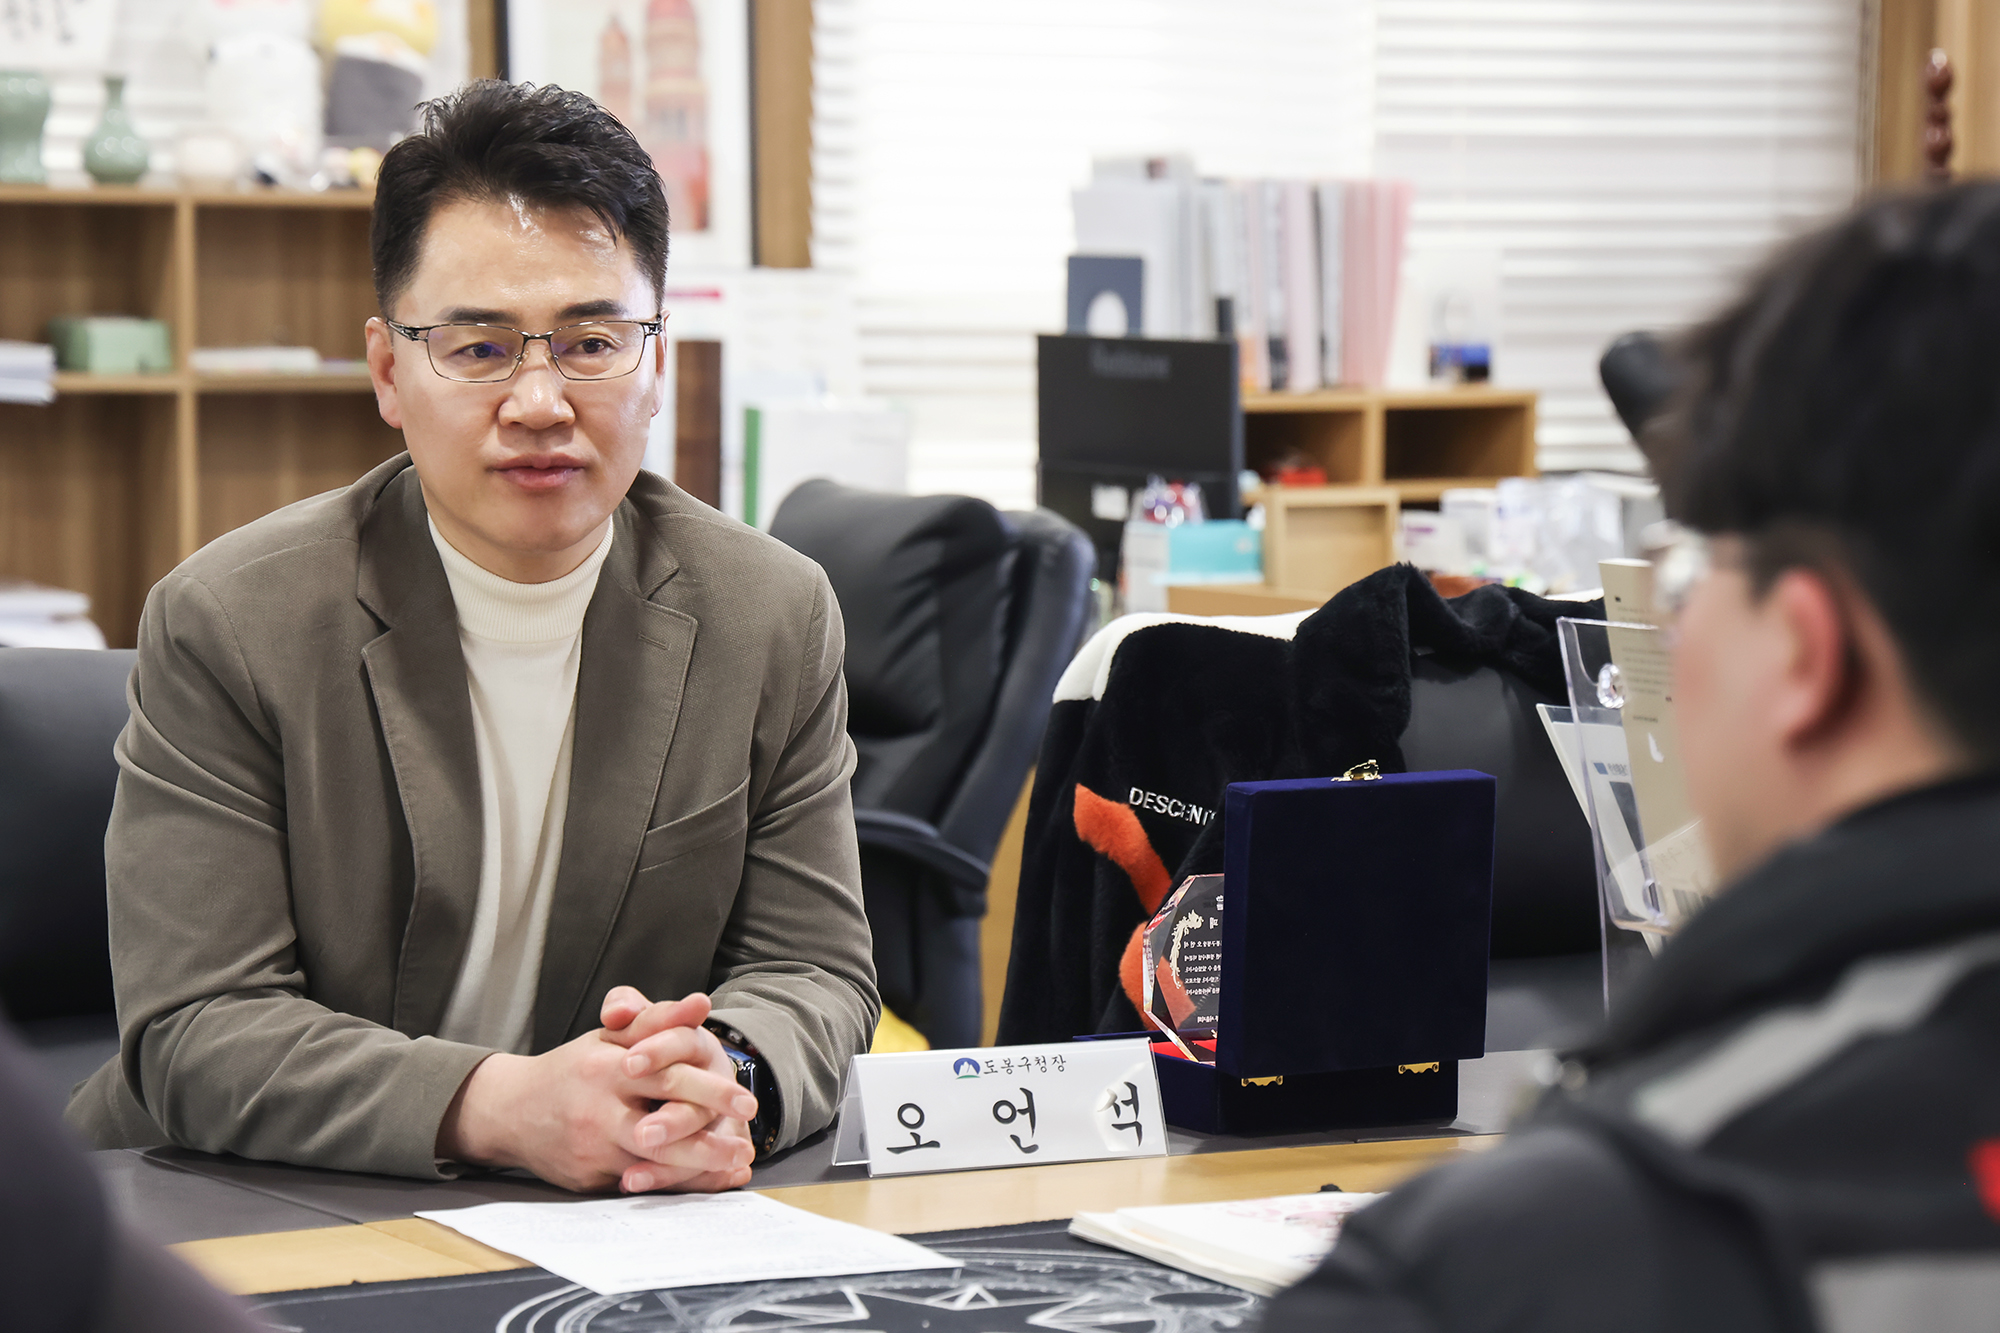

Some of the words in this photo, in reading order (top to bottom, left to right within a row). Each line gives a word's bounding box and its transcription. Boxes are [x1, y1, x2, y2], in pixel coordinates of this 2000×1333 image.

[983, 1053, 1067, 1076] 도봉구청장
[886, 1102, 941, 1155] 오
[992, 1086, 1039, 1154] 언
